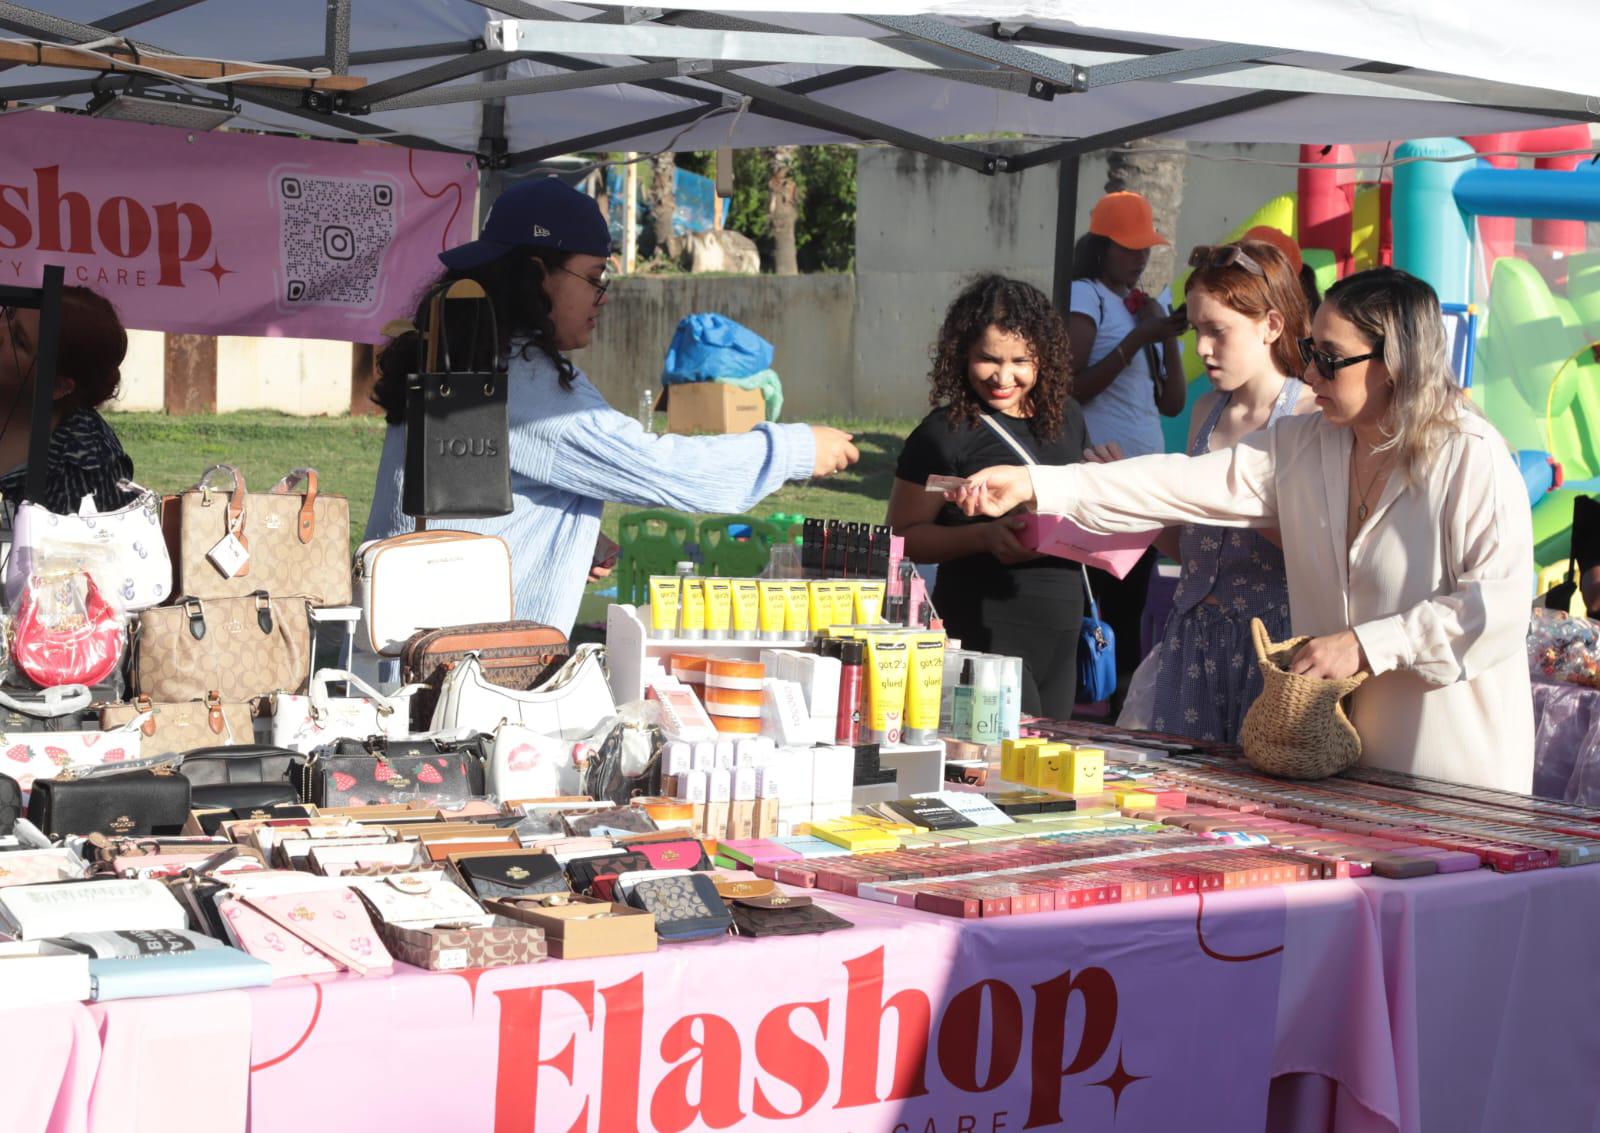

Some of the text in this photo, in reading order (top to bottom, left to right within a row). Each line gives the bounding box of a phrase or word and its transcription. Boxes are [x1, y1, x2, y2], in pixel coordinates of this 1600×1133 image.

[76, 265, 147, 287] CARE
[437, 437, 498, 458] TOUS
[493, 946, 1119, 1133] Elashop
